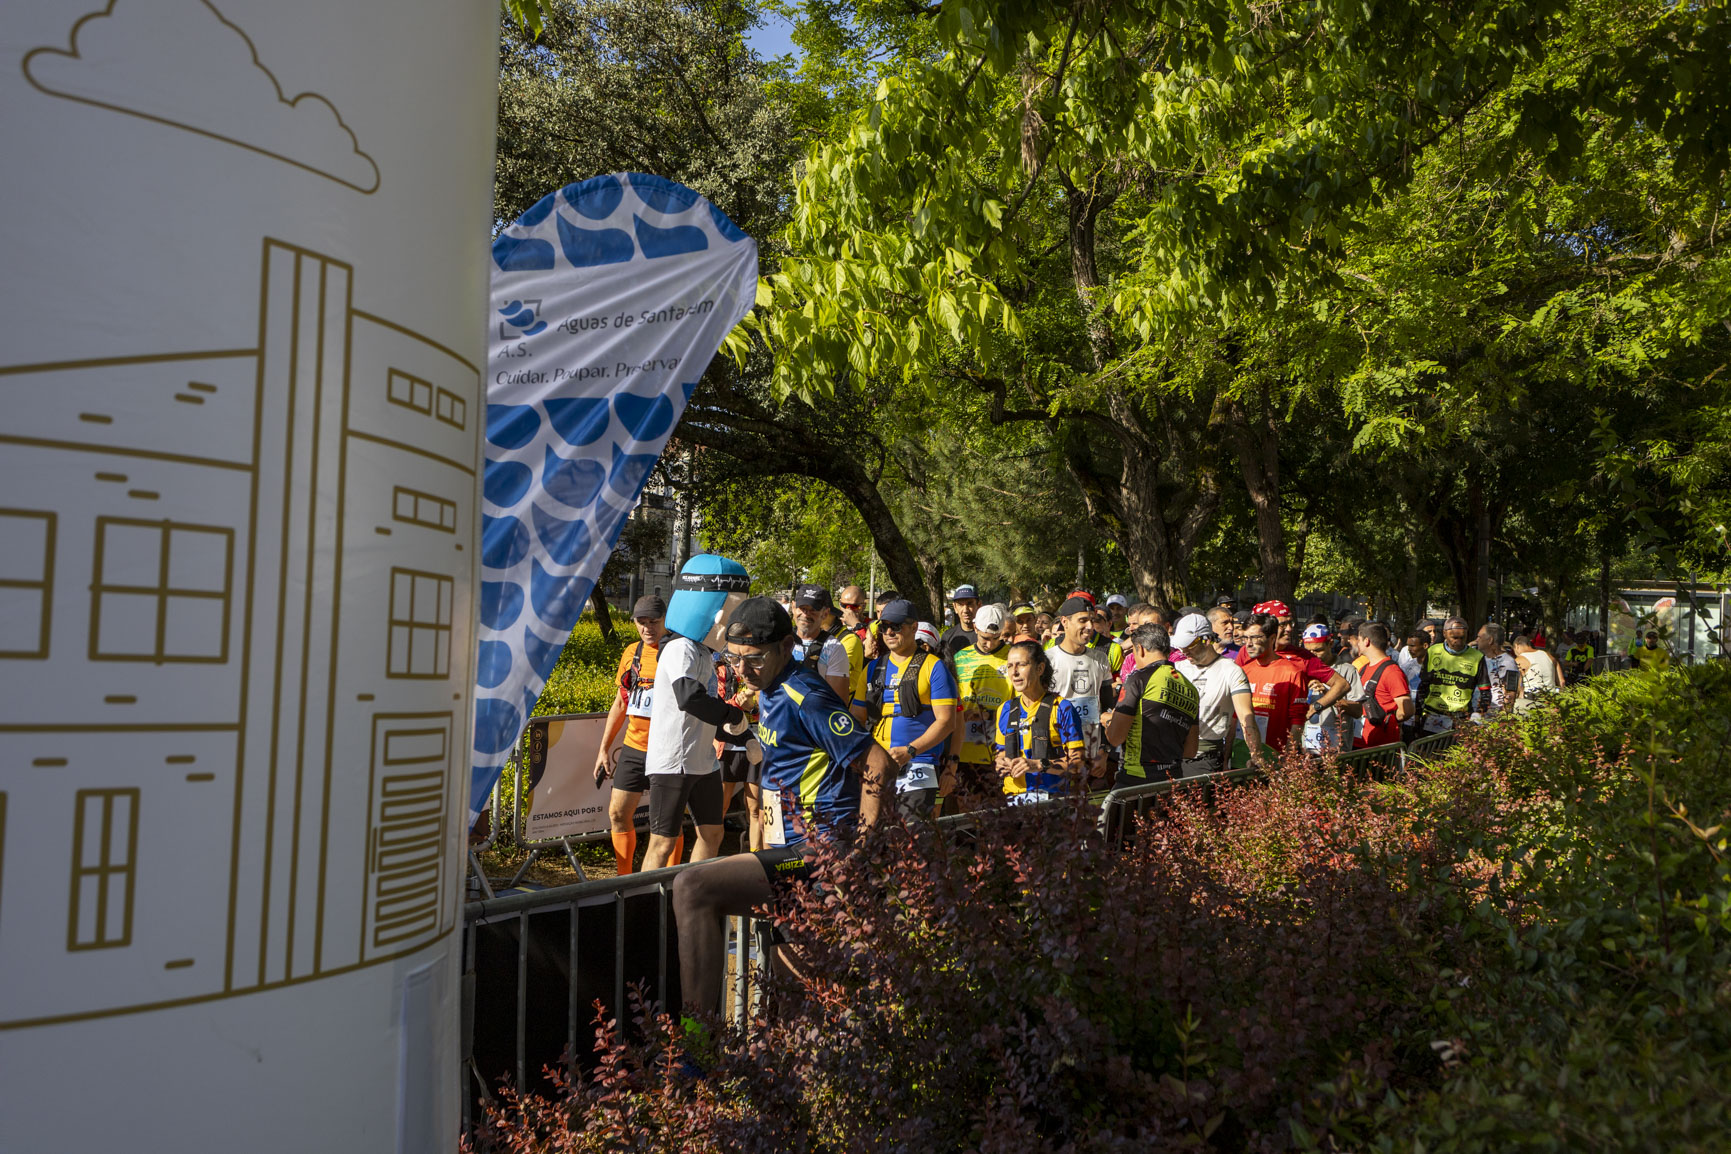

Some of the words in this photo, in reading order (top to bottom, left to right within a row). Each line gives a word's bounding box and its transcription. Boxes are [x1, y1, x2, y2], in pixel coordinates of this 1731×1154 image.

[613, 312, 634, 328] de
[497, 342, 533, 359] A.S.
[496, 369, 549, 385] Cuidar.
[553, 365, 610, 382] Poupar.
[833, 715, 850, 732] LR
[532, 810, 563, 821] ESTAMOS
[563, 808, 580, 818] AQUI
[581, 807, 596, 815] POR
